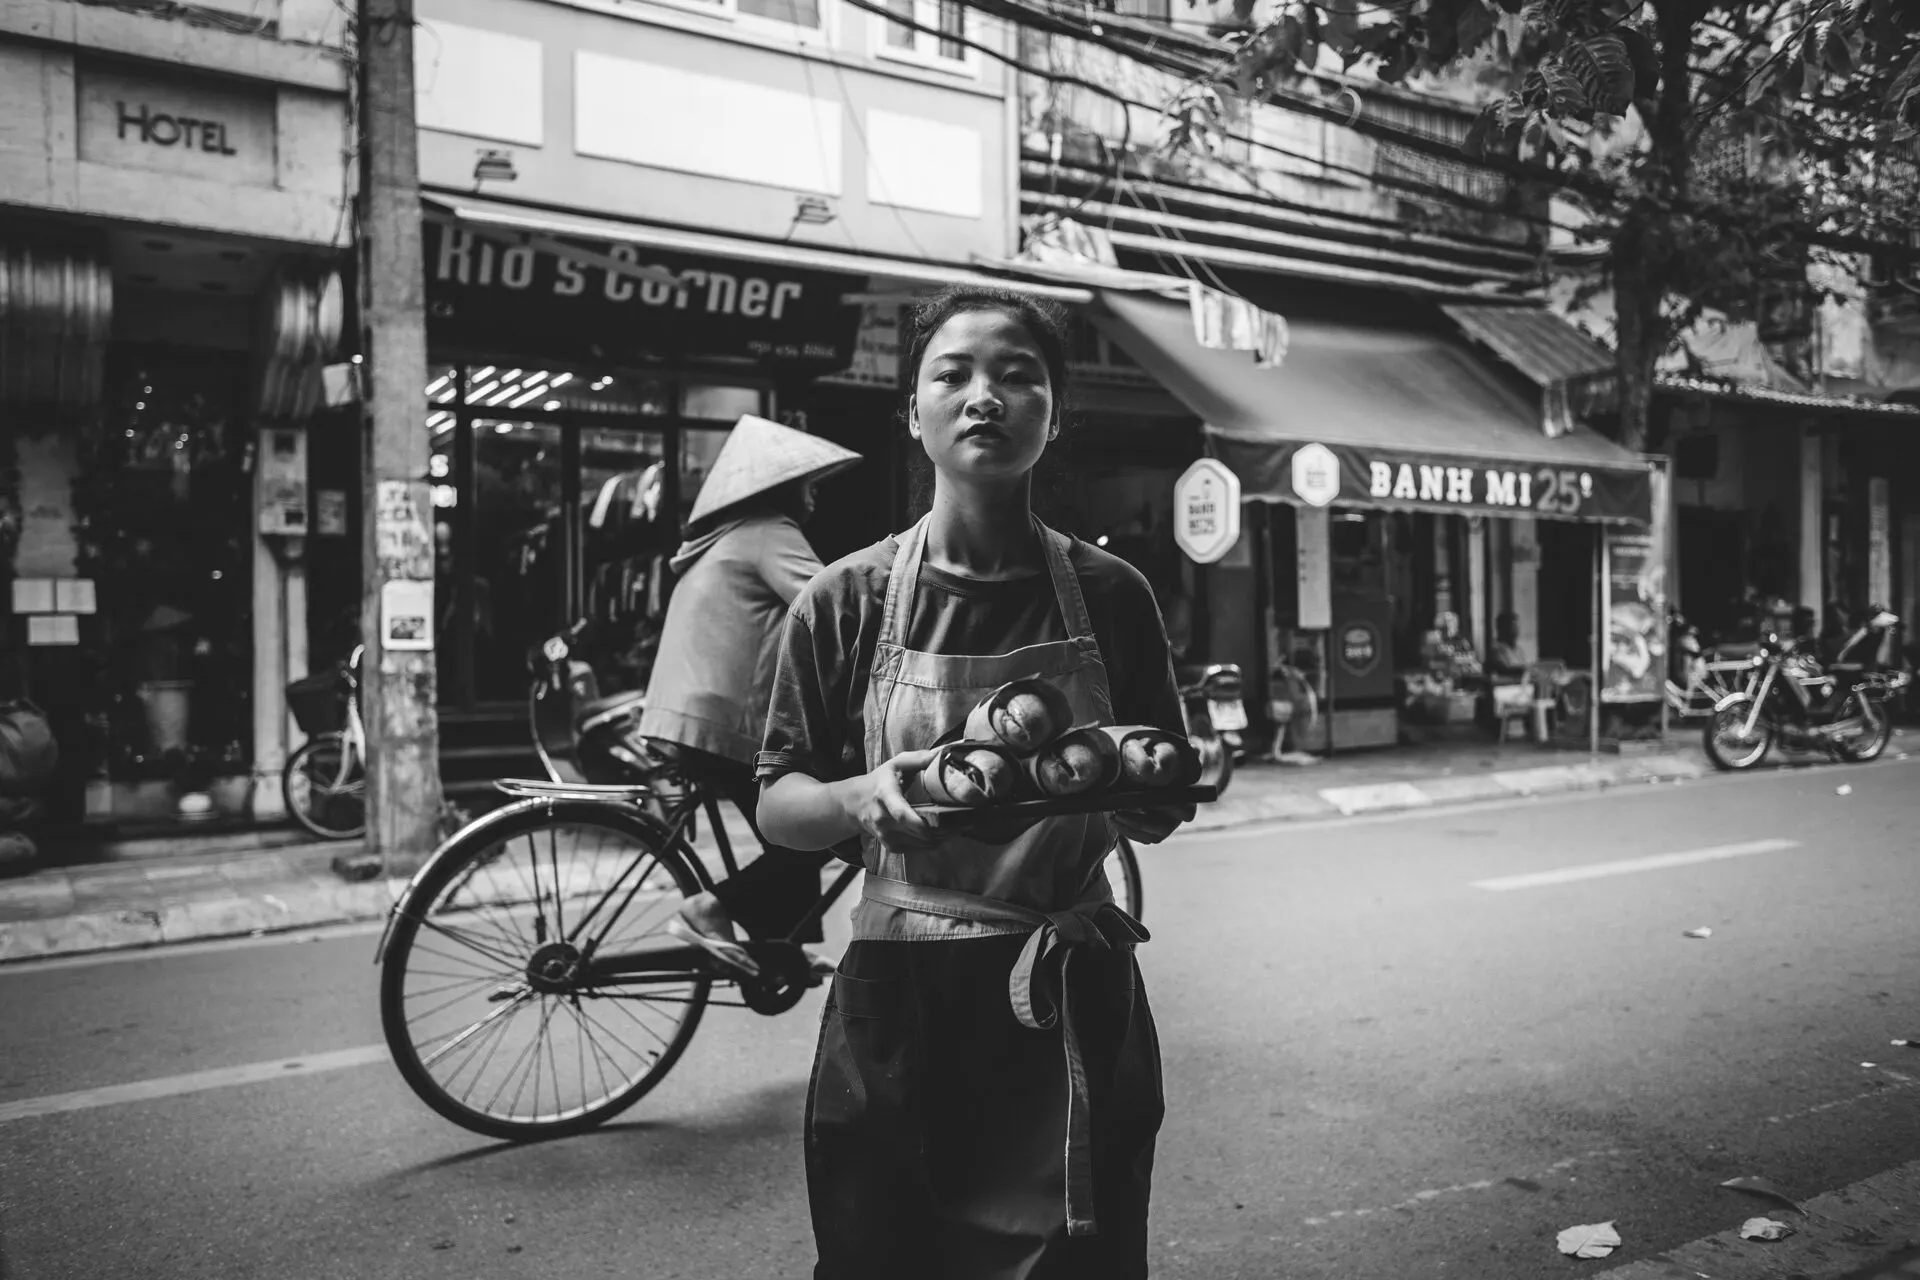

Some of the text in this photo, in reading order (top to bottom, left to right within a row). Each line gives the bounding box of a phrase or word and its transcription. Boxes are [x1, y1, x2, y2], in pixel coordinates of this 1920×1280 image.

[116, 100, 237, 156] HOTEL
[437, 223, 586, 295] Kids
[1370, 461, 1473, 503] BANH
[1485, 470, 1532, 507] MI
